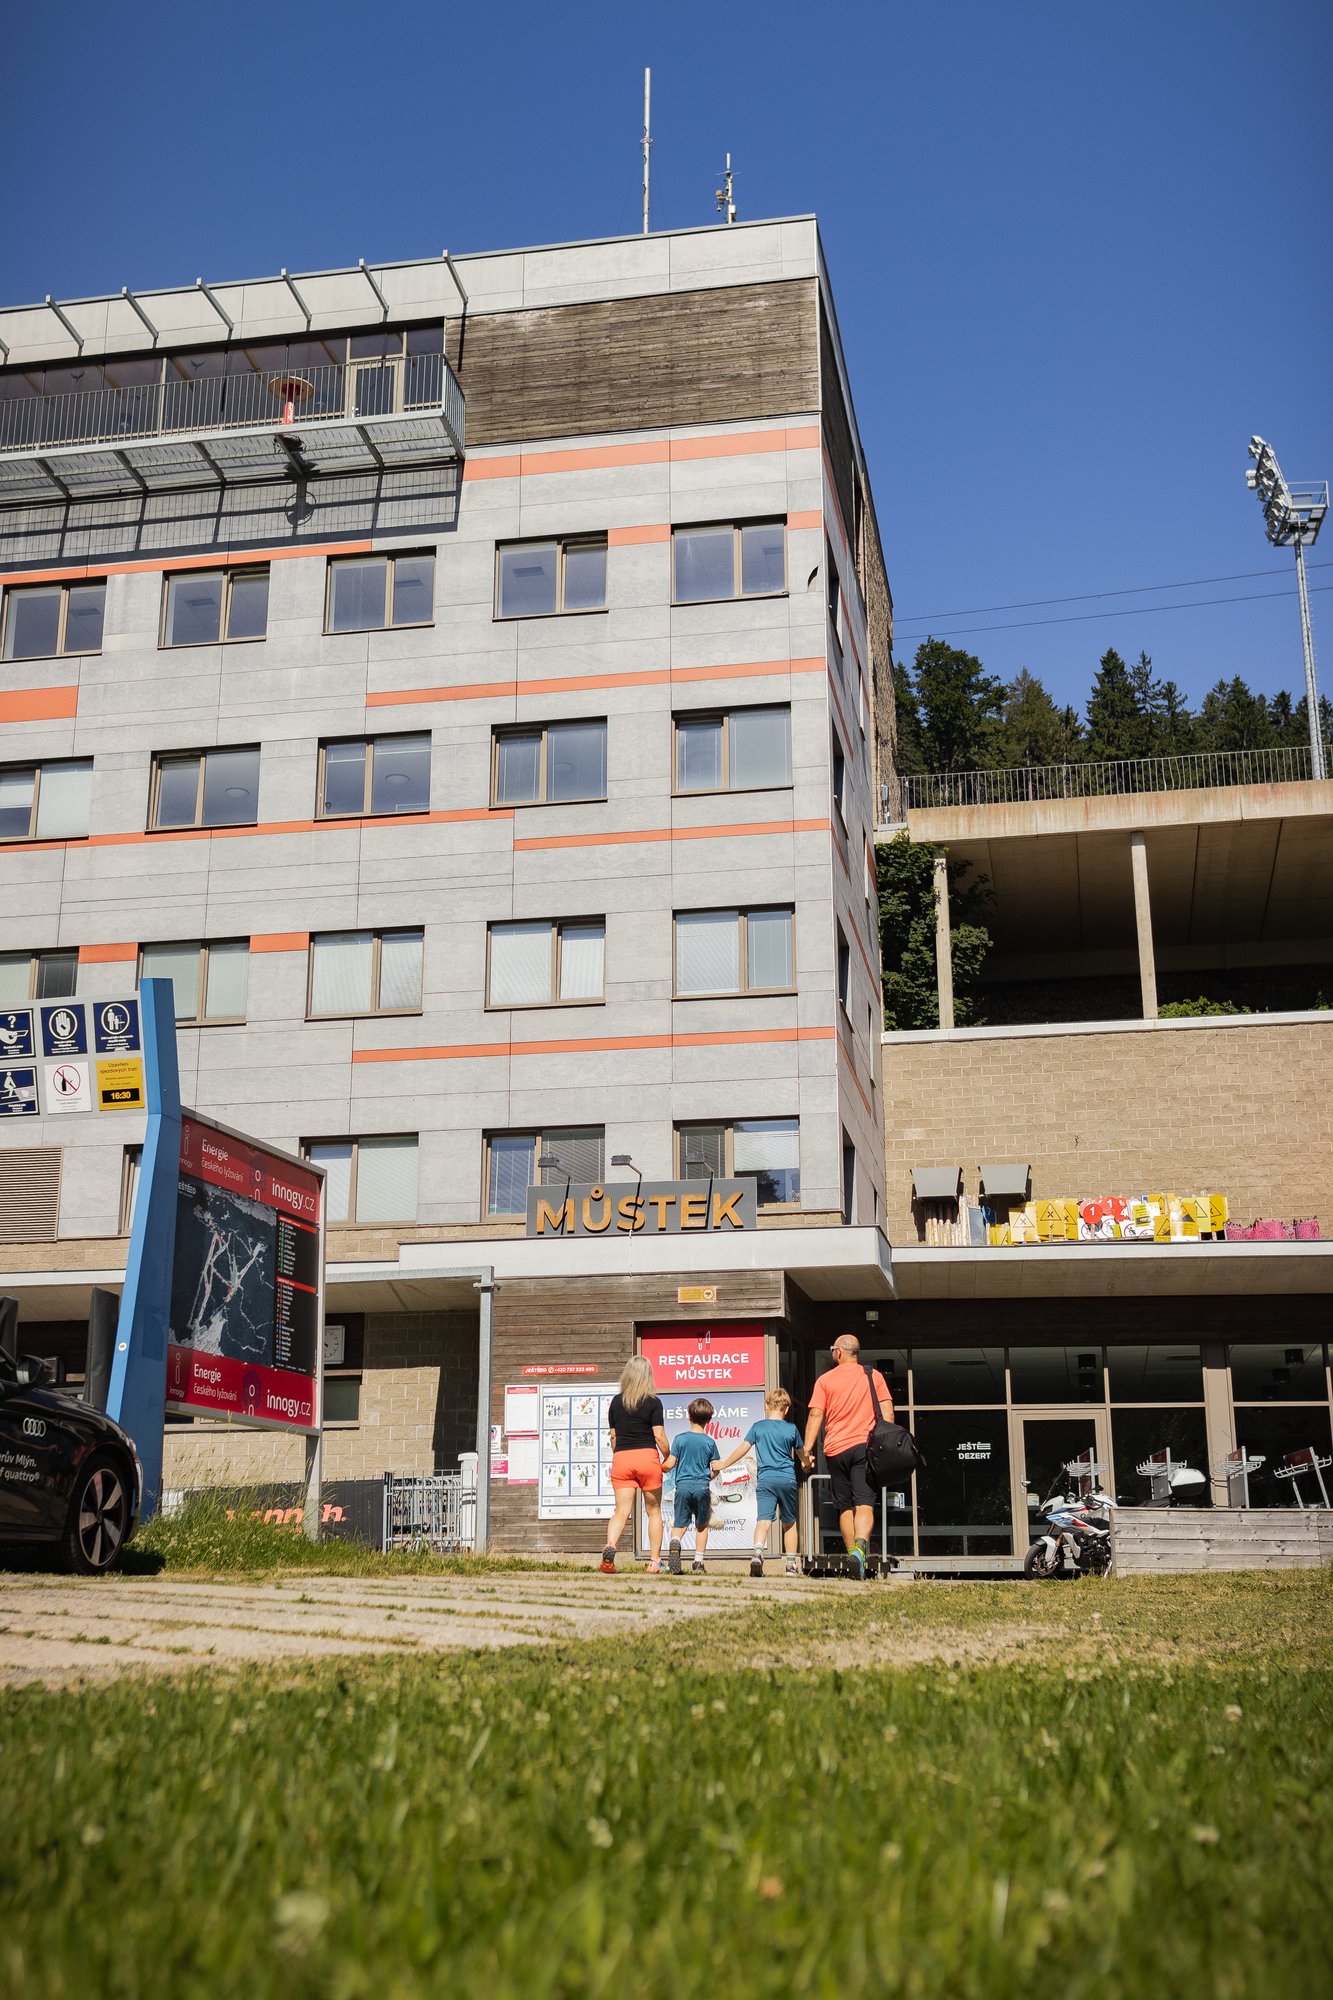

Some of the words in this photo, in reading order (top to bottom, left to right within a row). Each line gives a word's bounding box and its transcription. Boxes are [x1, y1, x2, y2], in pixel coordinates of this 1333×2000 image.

[110, 1091, 132, 1100] 16:30
[201, 1139, 229, 1161] Energie
[201, 1157, 223, 1175] českého
[223, 1165, 243, 1183] lyžování
[178, 1181, 197, 1195] EŠTĚD
[271, 1178, 315, 1212] innogy.cz
[536, 1185, 745, 1235] MŮSTEK
[1089, 1206, 1095, 1216] 1
[658, 1353, 749, 1366] RESTAURACE
[193, 1363, 222, 1384] Energie
[675, 1366, 732, 1380] MŮSTEK
[169, 1386, 186, 1398] innogy
[193, 1382, 216, 1397] českého
[216, 1386, 238, 1401] lyžování
[266, 1389, 312, 1418] innogy.cz
[705, 1421, 741, 1440] Menu
[958, 1452, 991, 1460] DEZERT
